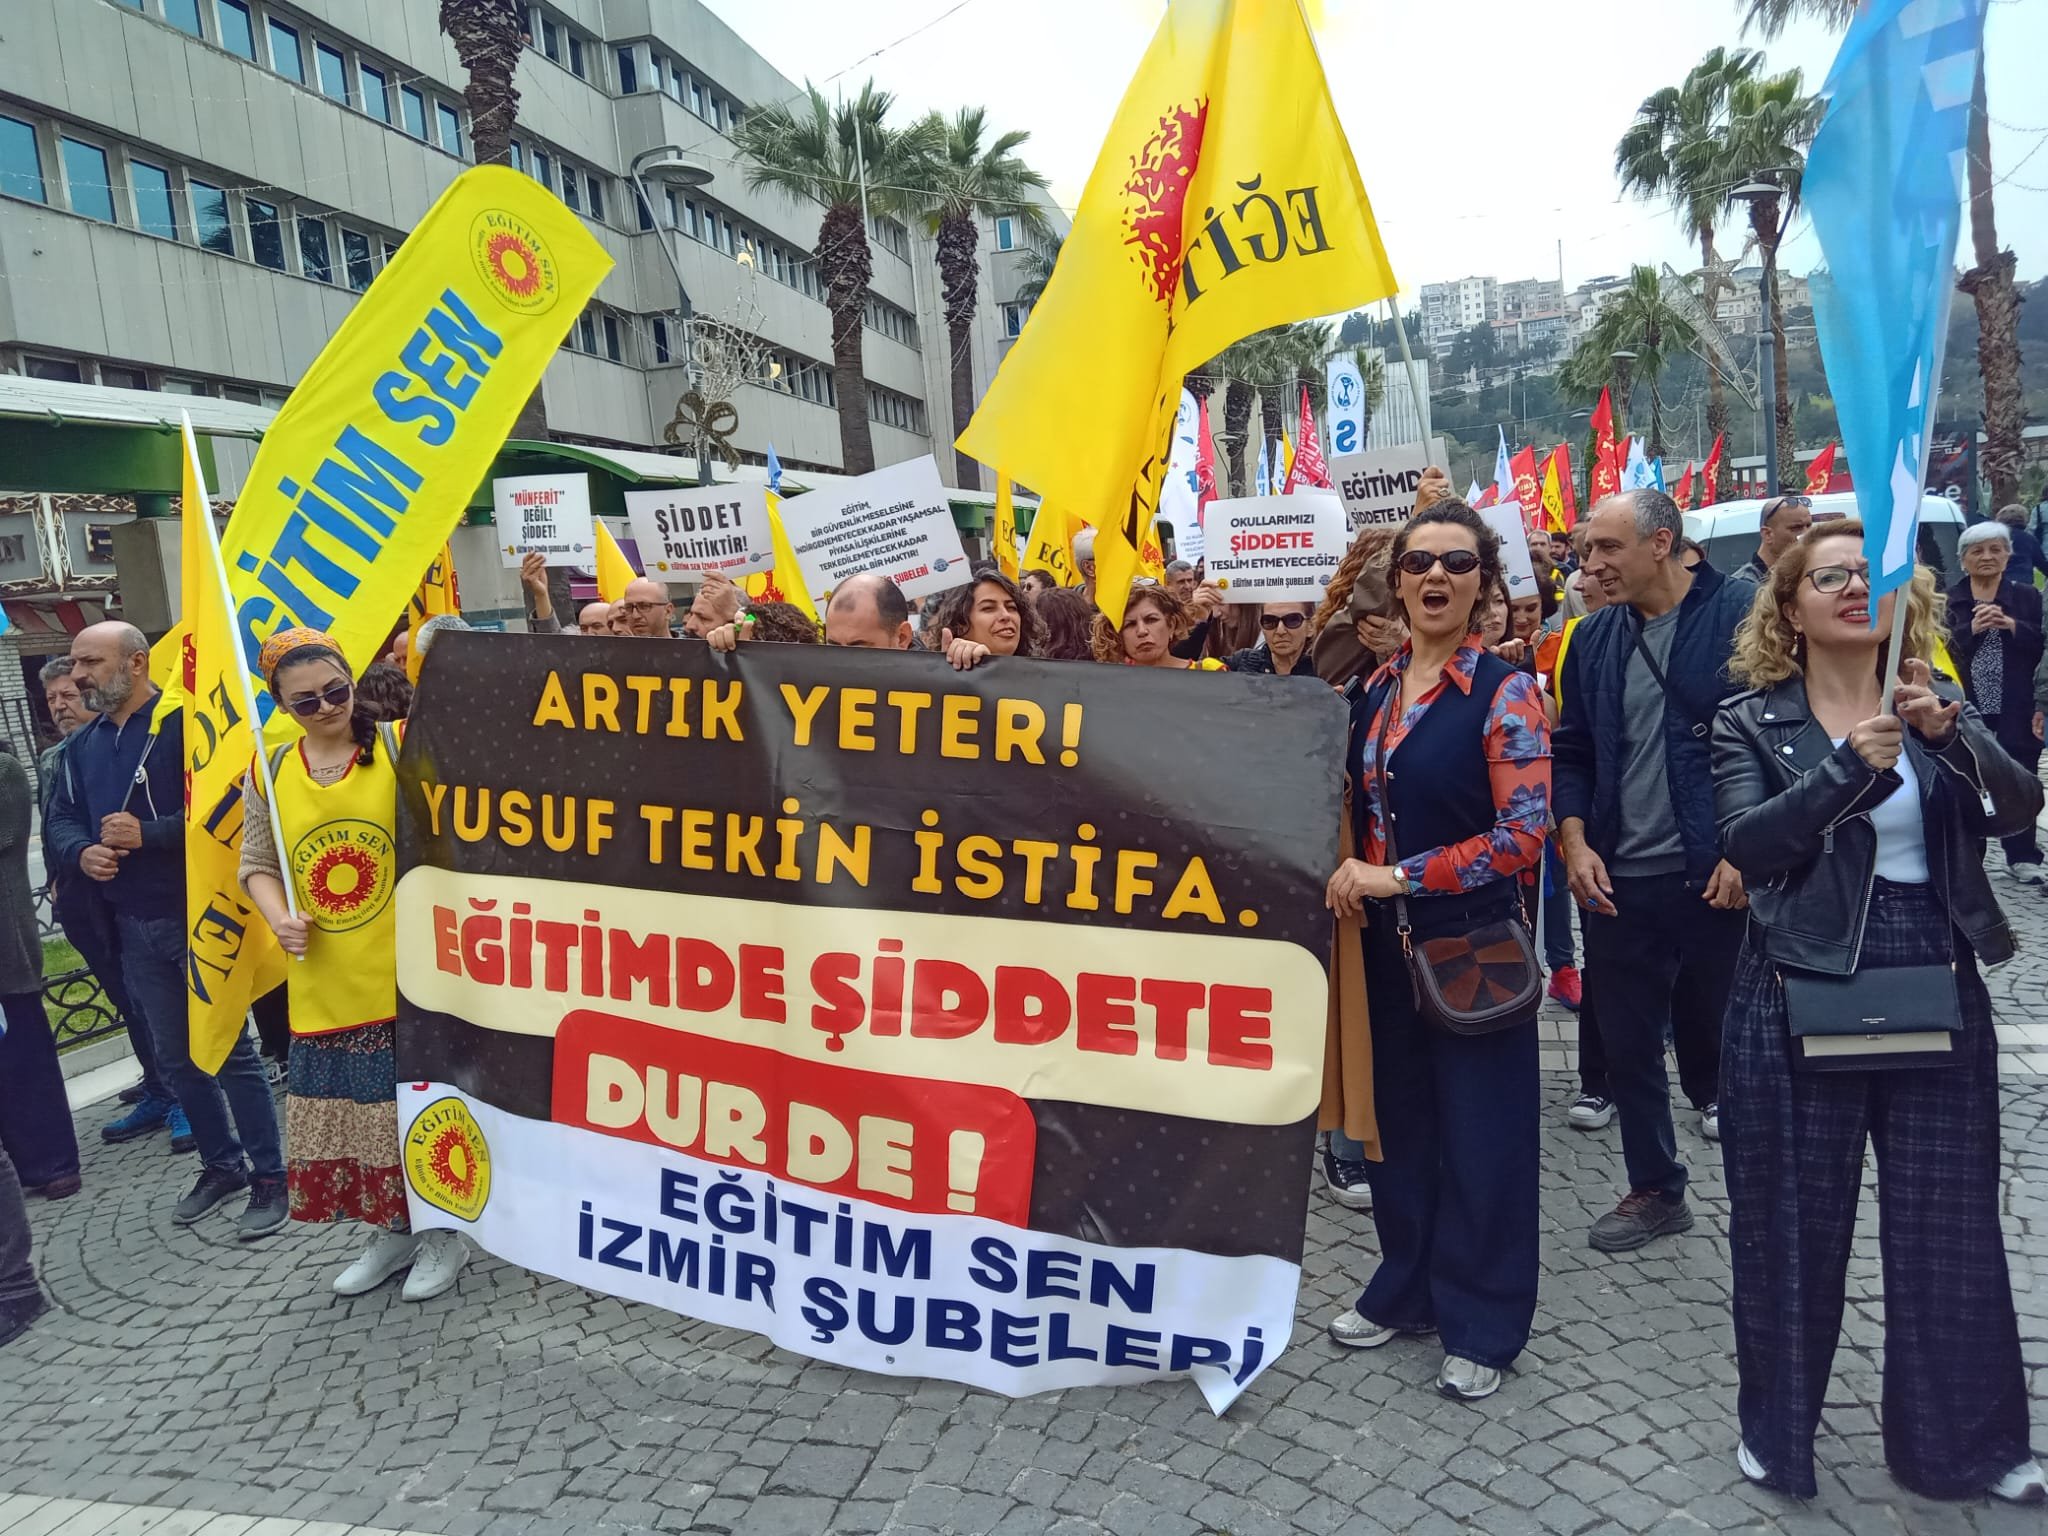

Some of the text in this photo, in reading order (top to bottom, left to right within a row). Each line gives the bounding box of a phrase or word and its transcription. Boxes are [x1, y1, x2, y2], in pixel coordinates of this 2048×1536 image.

[372, 288, 504, 447] SEN
[1341, 467, 1428, 500] EĞİTİMD
[524, 505, 553, 522] DEĞİL!
[655, 502, 742, 541] ŞİDDET
[810, 500, 915, 538] BİR GÜVENLİK MESELESİNE
[868, 519, 897, 534] KADAR
[1230, 514, 1315, 528] OKULLARIMIZI
[1351, 508, 1397, 527] ŞİDDETE
[522, 523, 557, 543] ŞİDDET!
[664, 534, 749, 559] POLİTİKTİR!
[829, 528, 907, 557] PİYASA İLİŞKİLERİNE
[898, 534, 928, 550] KADAR
[1230, 530, 1314, 556] ŞİDDETE
[833, 564, 869, 580] KAMUSAL
[870, 557, 884, 569] BİR
[884, 549, 919, 567] HAKTIR!
[894, 564, 929, 586] ŞUBELERİ
[1210, 553, 1339, 571] TESLİM ETMEYECEĞİZ!
[1253, 578, 1265, 587] SEN
[1266, 576, 1284, 587] İZMİR
[1286, 575, 1315, 589] ŞUBELERİ
[533, 670, 1083, 767] ARTIK YETER!
[295, 830, 389, 875] EĞİTİM SEN
[420, 781, 1259, 928] YUSUF TEKİN İSTİFA.
[433, 897, 1274, 1071] EĞİTİMDE ŞİDDETE
[413, 1105, 488, 1163] EĞİTİM SEN
[586, 1052, 767, 1165] DUR
[786, 1101, 914, 1201] DE
[660, 1167, 1156, 1314] EĞİTİM SEN
[578, 1199, 1265, 1387] İZMİR ŞUBELERİ
